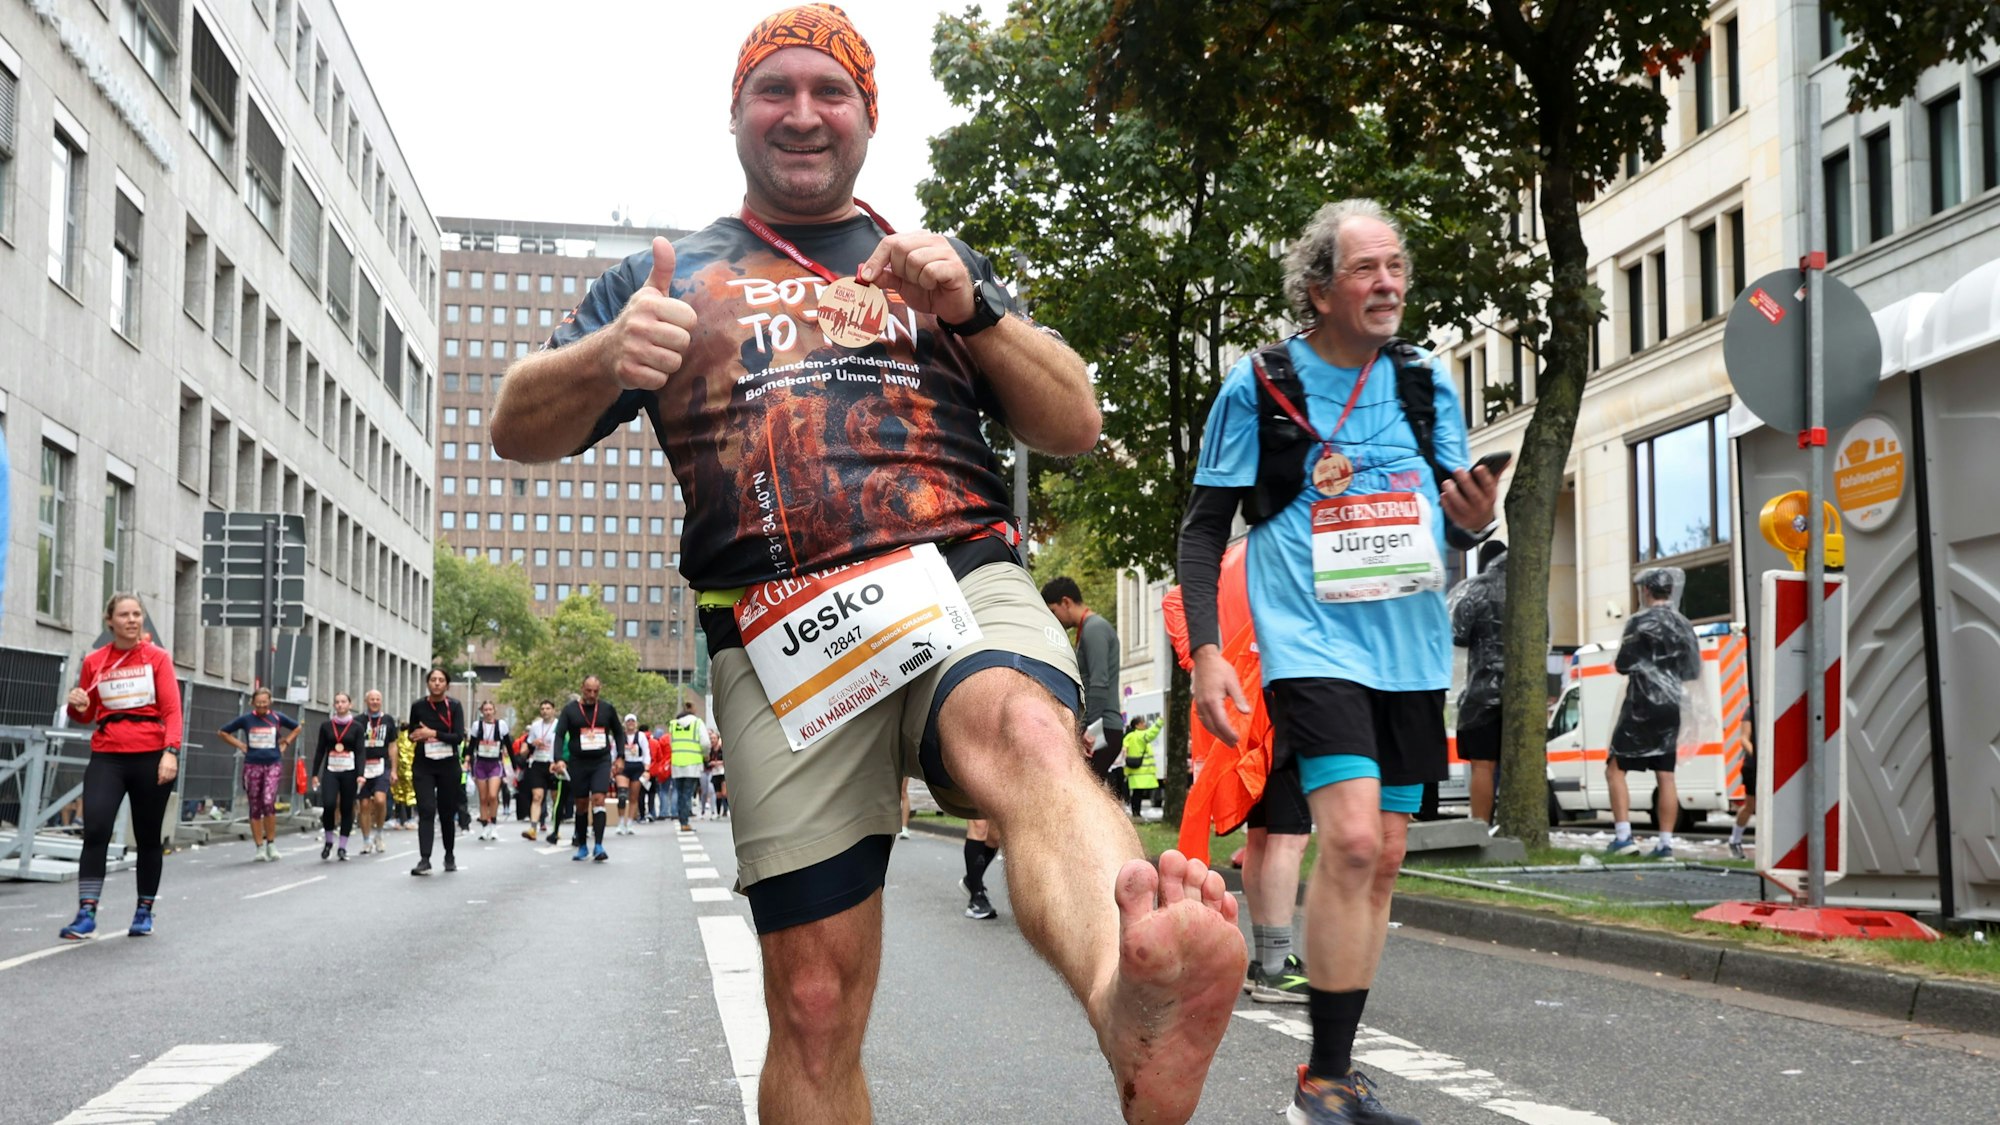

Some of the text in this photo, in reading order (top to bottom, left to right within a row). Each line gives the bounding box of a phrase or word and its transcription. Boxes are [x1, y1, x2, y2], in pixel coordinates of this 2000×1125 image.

[726, 276, 830, 308] BO
[737, 312, 798, 353] TO
[745, 368, 921, 402] Bornekamp Unna, NRW
[1331, 531, 1413, 555] Jürgen
[781, 583, 885, 658] Jesko
[870, 611, 934, 650] Startblock ORANGE
[945, 605, 968, 636] 12847
[823, 625, 863, 660] 12847
[899, 648, 933, 676] PUMA
[110, 681, 135, 690] Lena
[836, 674, 869, 701] GENERALI
[799, 682, 878, 741] KÖLN MARATHON
